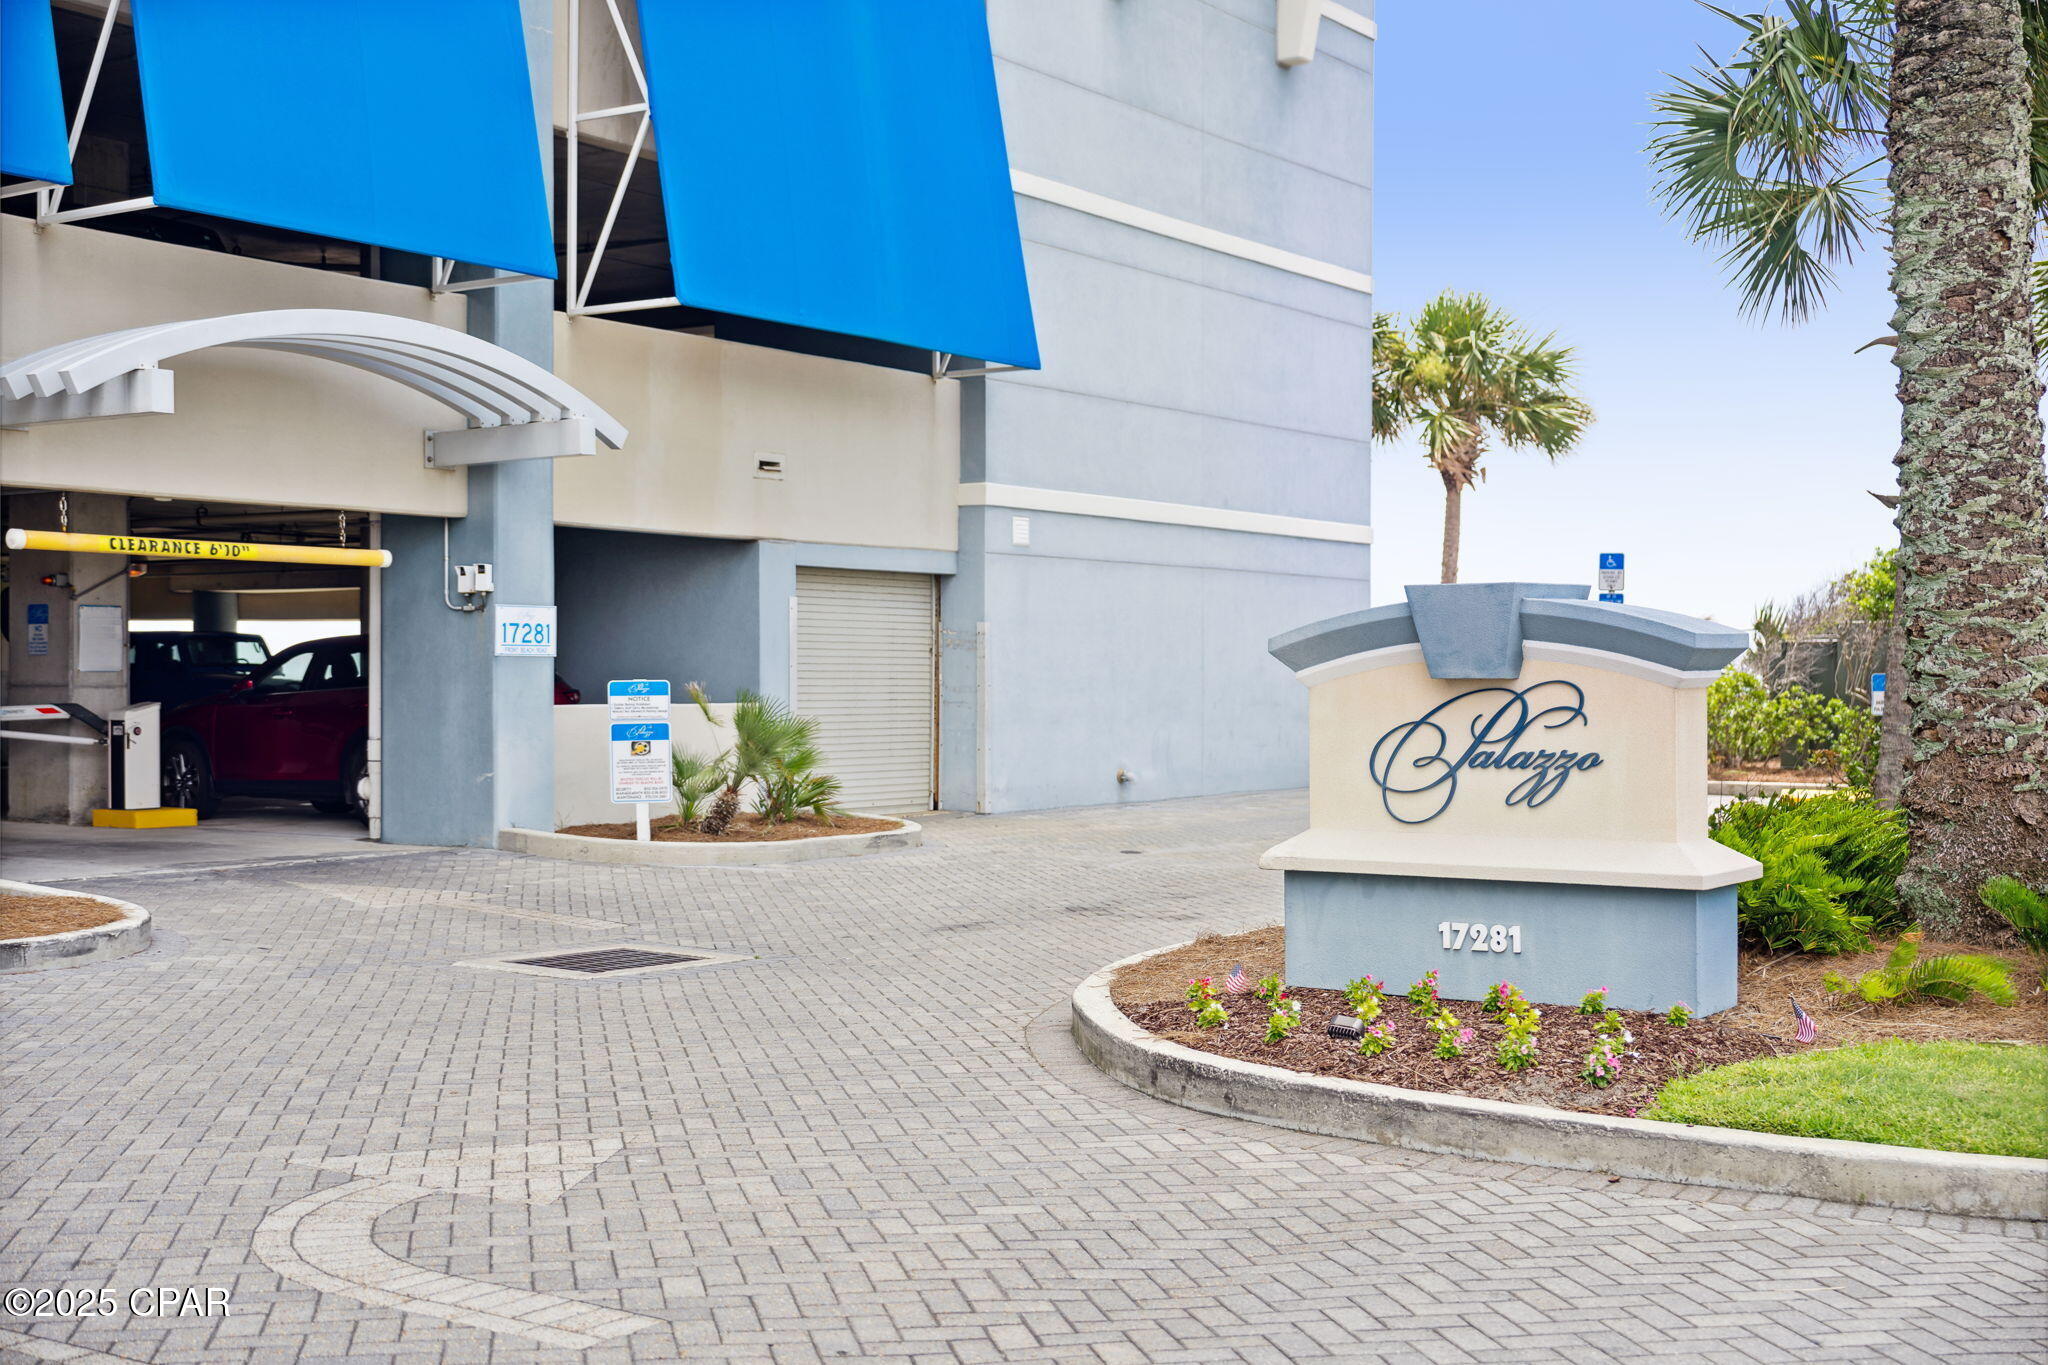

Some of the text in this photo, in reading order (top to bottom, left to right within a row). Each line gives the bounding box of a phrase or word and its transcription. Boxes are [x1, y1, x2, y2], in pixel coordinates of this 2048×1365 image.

[109, 537, 201, 555] CLEARANCE
[502, 622, 551, 644] 17281
[1369, 679, 1604, 825] Palazzo
[1438, 921, 1522, 954] 17281
